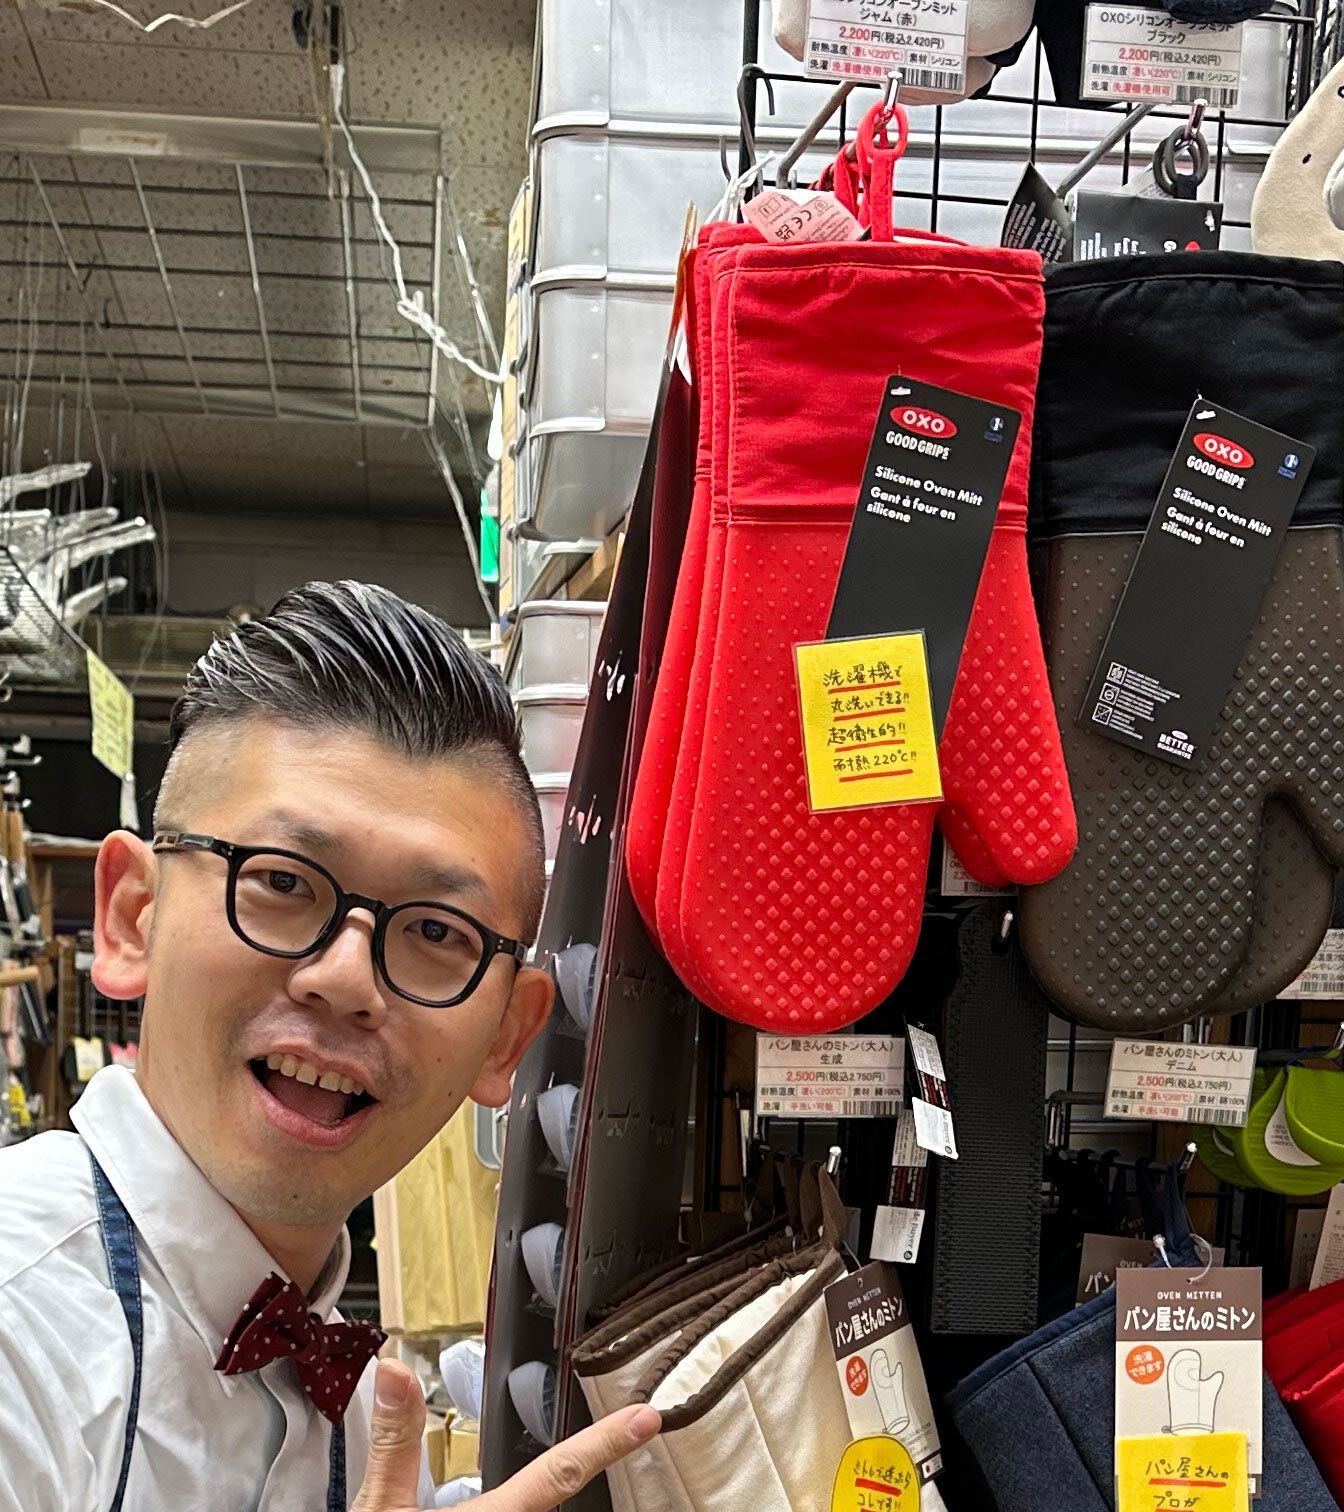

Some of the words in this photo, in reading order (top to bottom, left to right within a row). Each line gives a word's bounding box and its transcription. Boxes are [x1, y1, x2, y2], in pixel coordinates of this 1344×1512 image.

[1147, 30, 1186, 44] ブラック
[902, 410, 945, 433] OXO
[886, 431, 918, 450] GOOD
[1204, 438, 1243, 463] OXO
[1186, 455, 1216, 476] GOOD
[875, 465, 921, 489] Silicone
[924, 480, 956, 499] Oven
[957, 489, 983, 506] Mitt
[866, 502, 911, 523] silicone
[871, 487, 901, 505] Gant
[912, 498, 938, 515] four
[940, 509, 956, 521] en
[1173, 487, 1215, 513] Silicone
[1216, 506, 1246, 527] Oven
[1248, 519, 1272, 537] Mitt
[1161, 522, 1203, 545] silicone
[1166, 507, 1194, 527] Gant
[1204, 522, 1229, 540] four
[1229, 535, 1245, 548] en
[1166, 1061, 1197, 1072] デニム
[1157, 1291, 1181, 1300] OVEN
[1186, 1291, 1222, 1299] MITTEN
[835, 1297, 902, 1348] パン屋さんのミトン
[1123, 1305, 1255, 1332] パン屋さんのミトン
[1145, 1457, 1229, 1478] パン屋さんの
[1153, 1491, 1201, 1508] プロが
